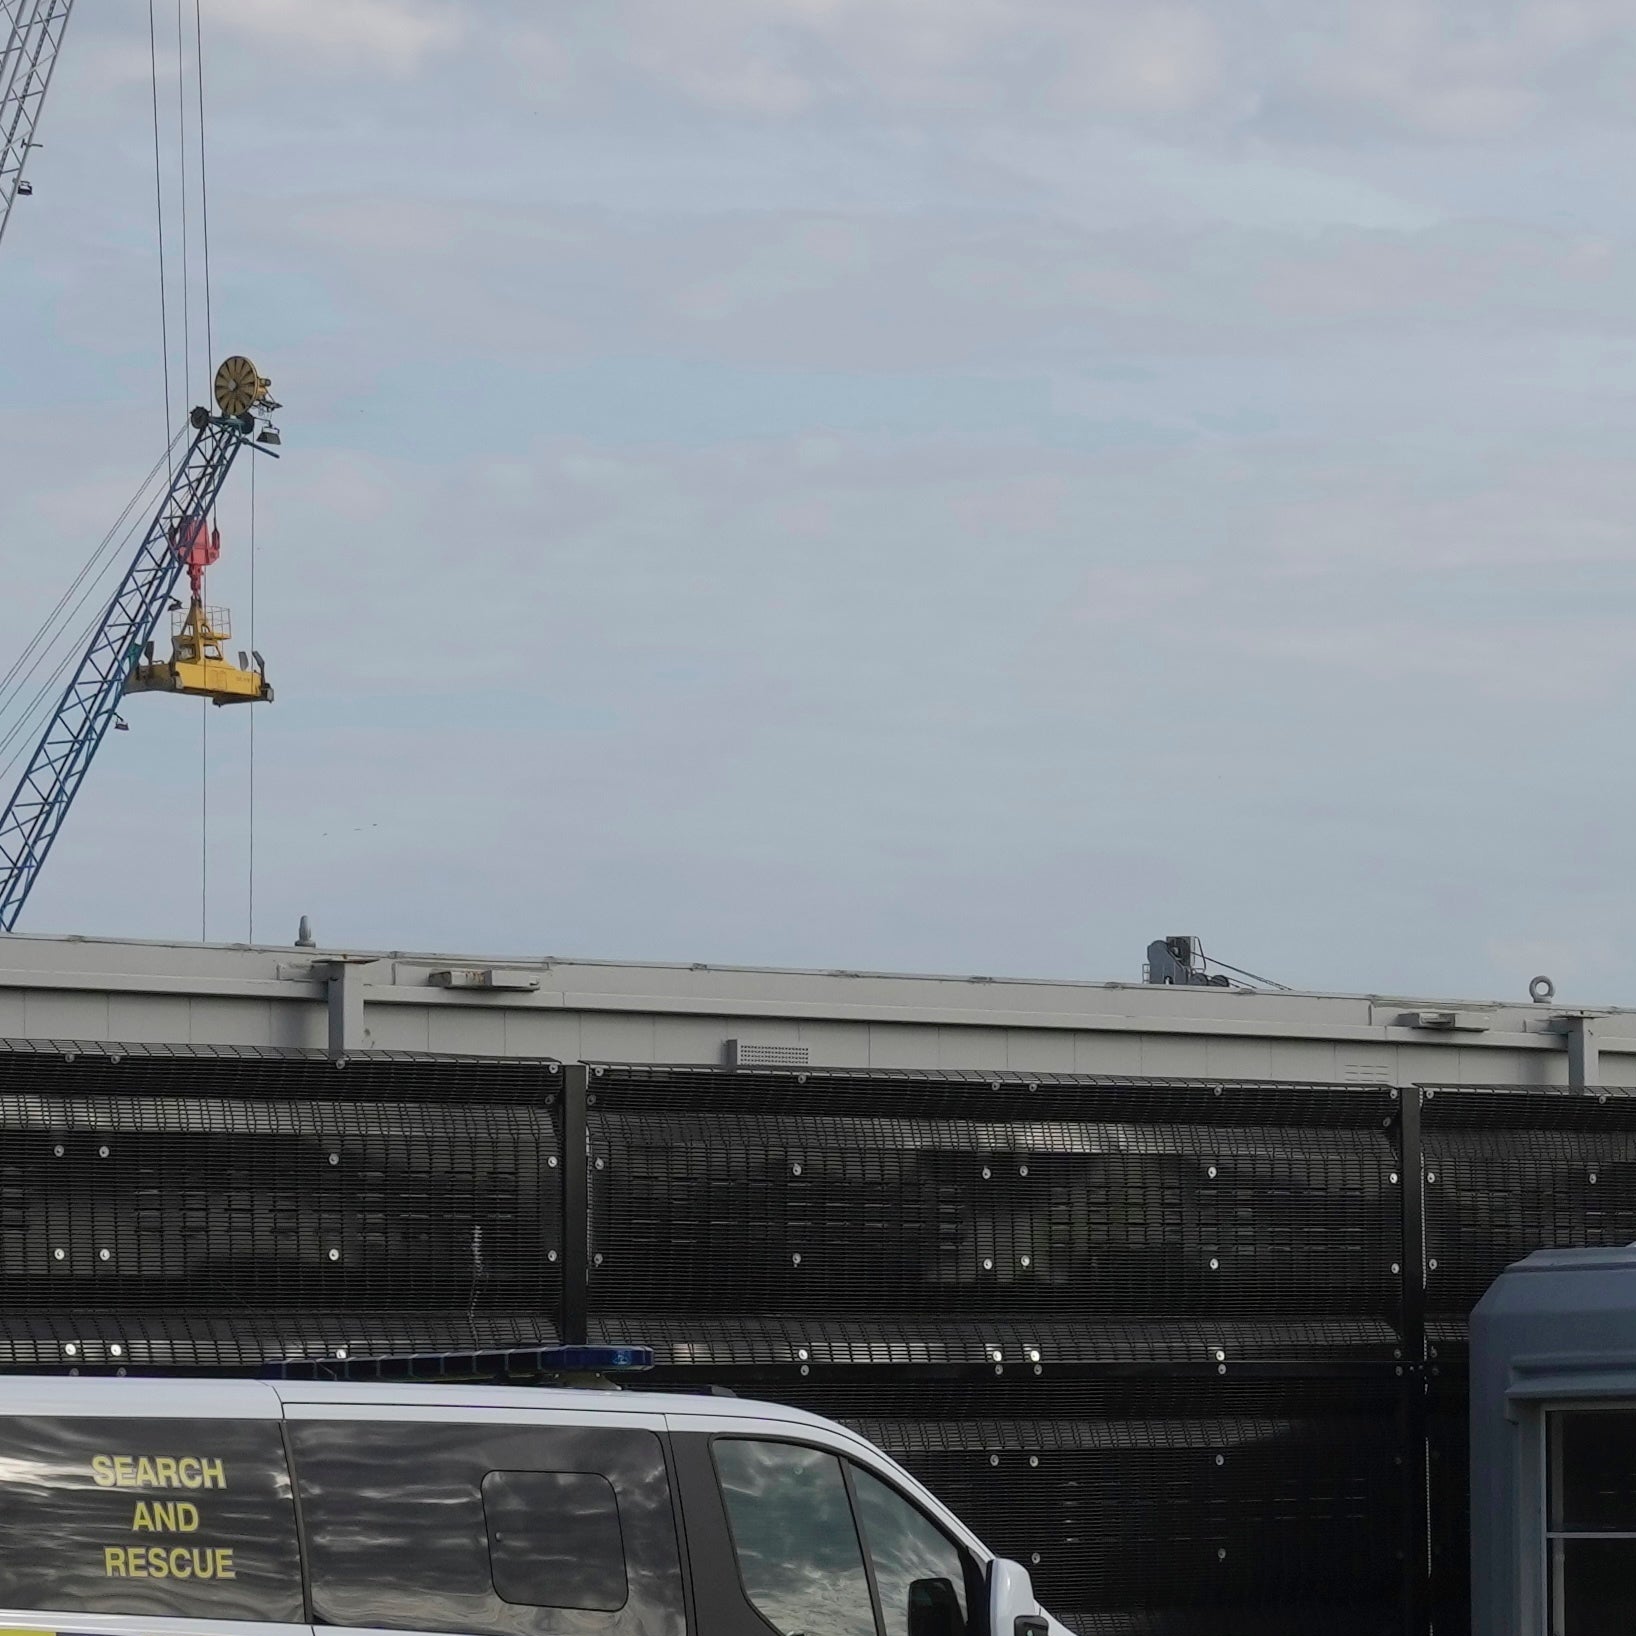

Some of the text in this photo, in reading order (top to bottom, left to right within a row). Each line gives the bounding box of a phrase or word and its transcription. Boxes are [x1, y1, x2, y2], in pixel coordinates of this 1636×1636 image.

[91, 1454, 227, 1491] SEARCH
[132, 1501, 200, 1532] AND
[104, 1546, 236, 1581] RESCUE
